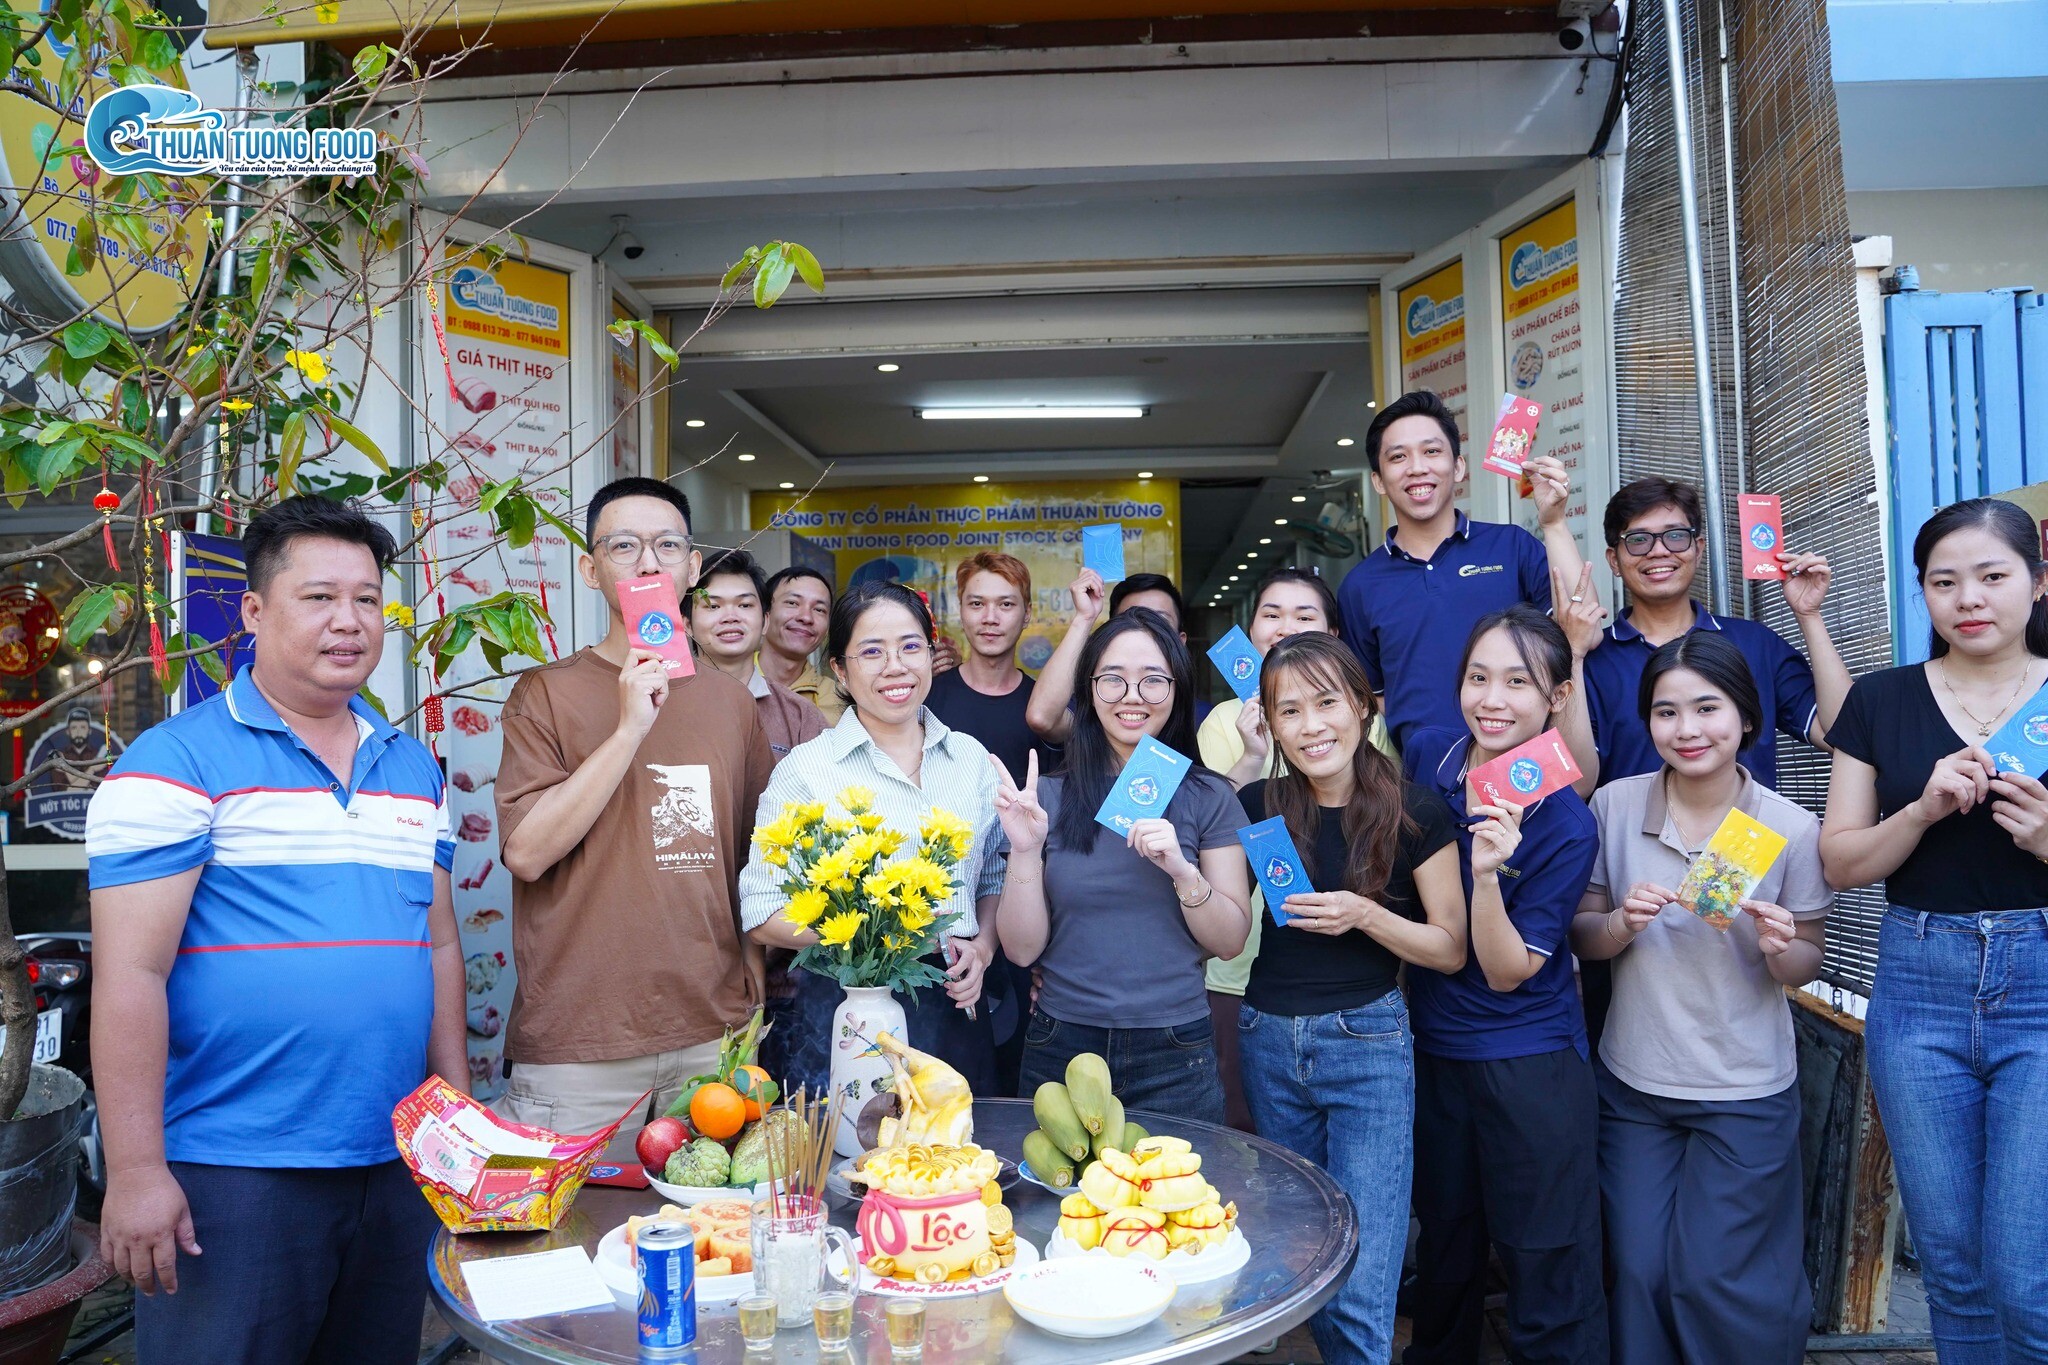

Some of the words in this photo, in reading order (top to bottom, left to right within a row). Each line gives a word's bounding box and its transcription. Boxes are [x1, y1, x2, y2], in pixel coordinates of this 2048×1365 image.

[536, 304, 557, 321] FOOD
[457, 348, 483, 367] GIÁ
[488, 354, 520, 376] THỊT
[524, 362, 553, 380] HEO
[542, 402, 560, 413] HEO
[505, 442, 525, 454] THỊT
[528, 444, 540, 454] BA
[536, 492, 557, 502] NON
[770, 509, 823, 527] CÔNG
[828, 512, 846, 525] TY
[852, 504, 879, 524] CỔ
[884, 504, 926, 524] PHẦN
[936, 507, 981, 526] THỰC
[986, 500, 1036, 521] PHẨM
[1041, 504, 1097, 522] THUẬN
[1103, 502, 1163, 518] TƯỜNG
[546, 536, 566, 546] NON
[846, 536, 901, 548] TUONG
[906, 534, 950, 547] FOOD
[954, 532, 1000, 546] JOINT
[1004, 530, 1056, 544] STOCK
[61, 796, 81, 812] TÓC
[640, 1322, 660, 1338] Tiger
